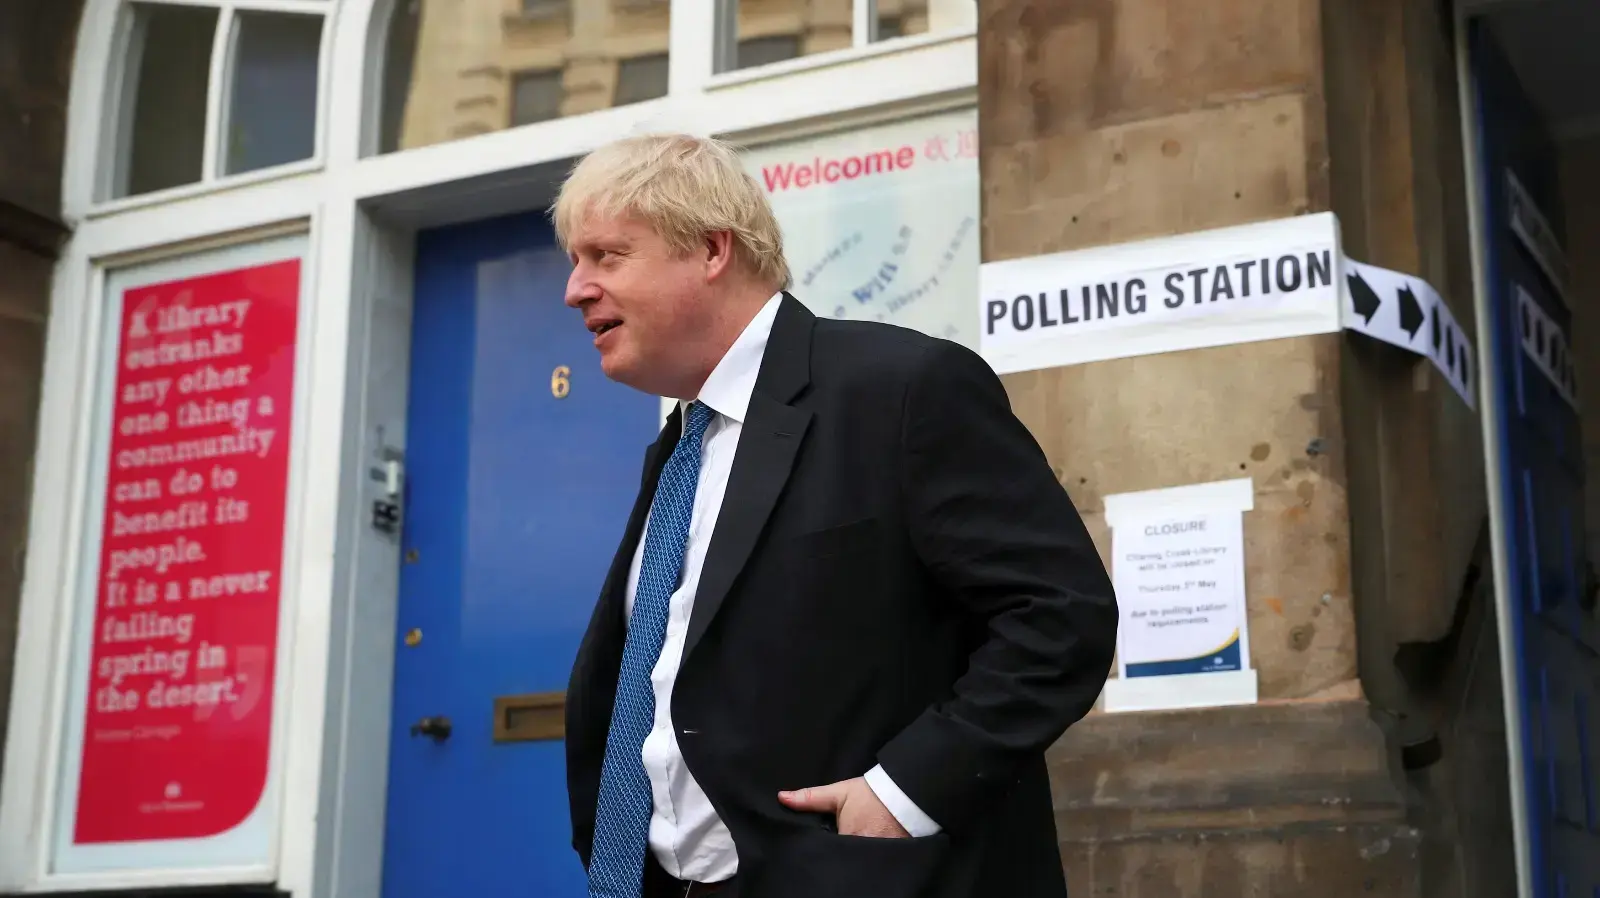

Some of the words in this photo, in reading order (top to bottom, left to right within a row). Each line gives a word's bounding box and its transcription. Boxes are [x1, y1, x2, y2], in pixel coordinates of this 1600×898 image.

[762, 144, 916, 193] Welcome
[987, 278, 1147, 335] POLLING
[1162, 250, 1332, 310] STATION
[158, 301, 251, 332] library
[127, 333, 243, 368] outranks
[123, 380, 171, 406] any
[179, 365, 251, 393] other
[551, 366, 570, 398] 6
[121, 413, 168, 435] one
[179, 399, 248, 427] thing
[259, 397, 273, 415] a
[119, 429, 275, 468] community
[116, 479, 161, 501] can
[171, 469, 204, 494] do
[213, 465, 237, 489] to
[113, 502, 207, 535] benefit
[216, 499, 248, 523] its
[1144, 519, 1208, 537] CLOSURE
[108, 537, 206, 578] people.
[106, 582, 127, 607] It
[136, 579, 158, 604] is
[166, 583, 181, 601] a
[190, 572, 271, 599] never
[103, 612, 195, 643] failing
[99, 647, 189, 685] spring
[198, 642, 226, 669] in
[97, 685, 139, 713] the
